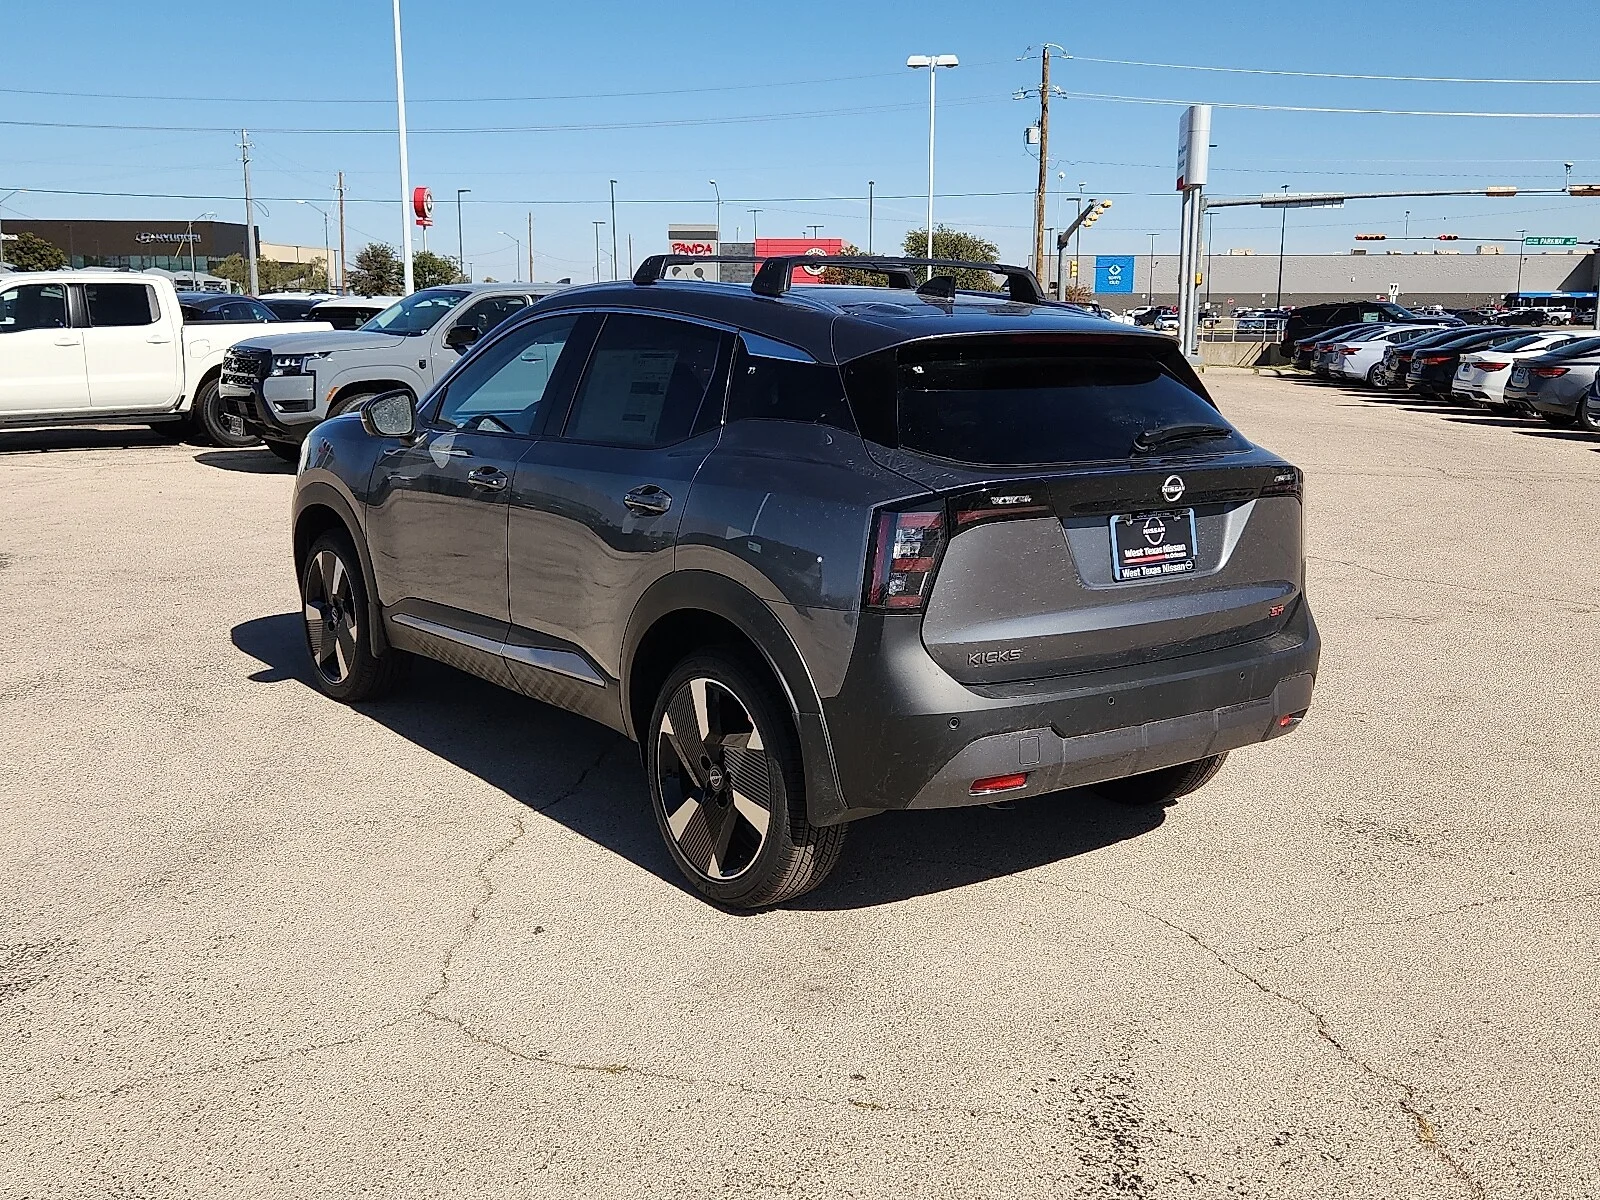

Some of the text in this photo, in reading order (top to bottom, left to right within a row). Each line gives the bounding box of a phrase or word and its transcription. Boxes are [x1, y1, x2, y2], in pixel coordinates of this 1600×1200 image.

[671, 242, 713, 256] PANDA
[1142, 526, 1166, 535] NISSAN
[1124, 544, 1187, 558] West Texas Nissan
[1121, 562, 1186, 578] West Texas Nissan
[967, 649, 1021, 665] KICKS
